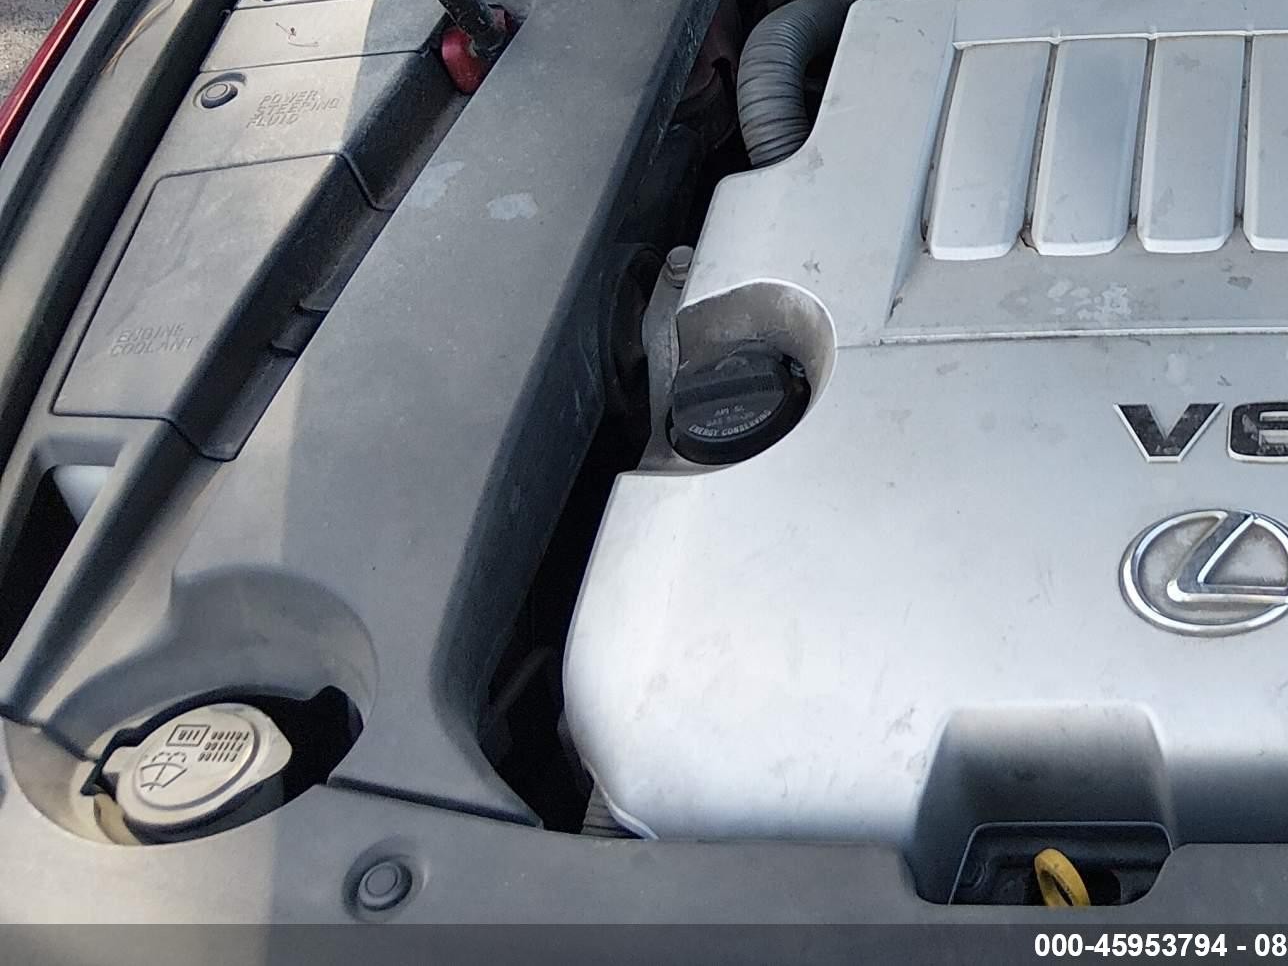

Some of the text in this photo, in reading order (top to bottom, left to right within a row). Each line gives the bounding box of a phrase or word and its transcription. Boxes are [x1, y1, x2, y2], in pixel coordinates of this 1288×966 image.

[259, 89, 319, 106] POWER
[254, 97, 340, 117] STEERING
[246, 113, 299, 129] FLUID
[110, 335, 200, 357] COOLANT
